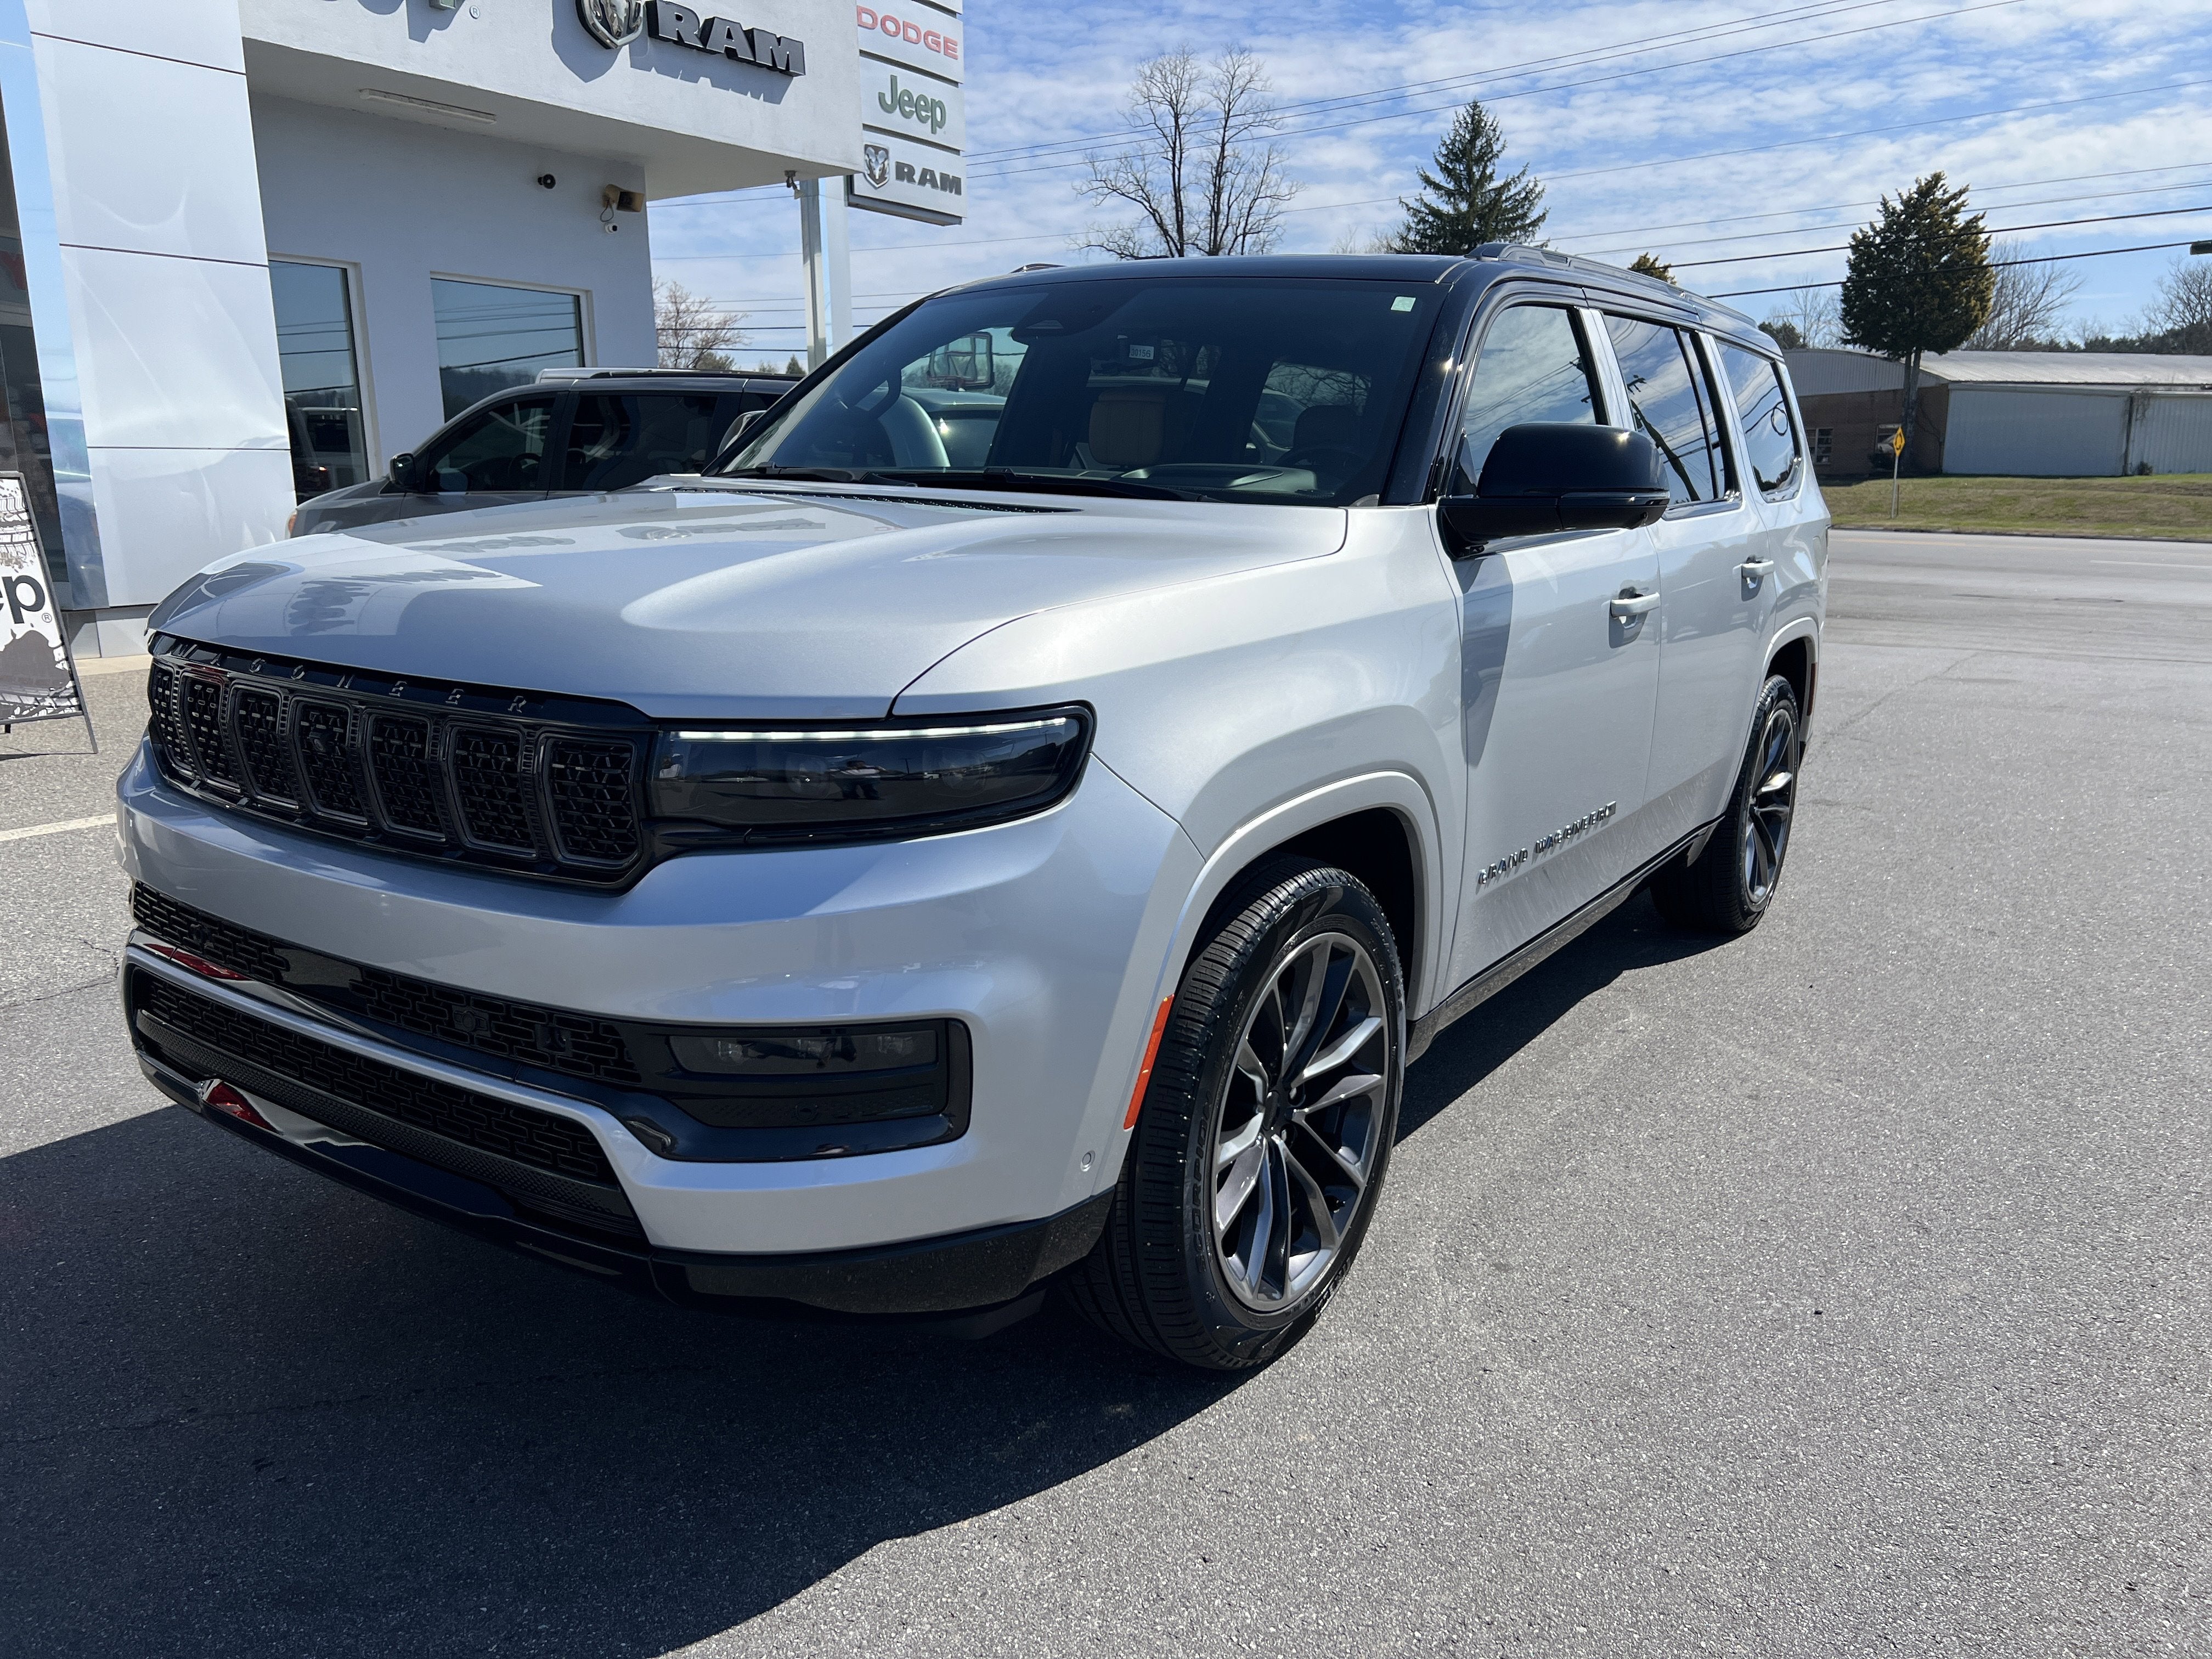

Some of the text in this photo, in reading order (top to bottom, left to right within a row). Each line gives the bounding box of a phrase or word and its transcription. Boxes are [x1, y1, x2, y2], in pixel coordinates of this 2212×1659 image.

[646, 1, 806, 77] RAM
[856, 5, 958, 60] DODGE
[878, 74, 947, 135] Jeep
[895, 161, 962, 196] RAM
[1479, 807, 1605, 884] GRAND WAGONEER
